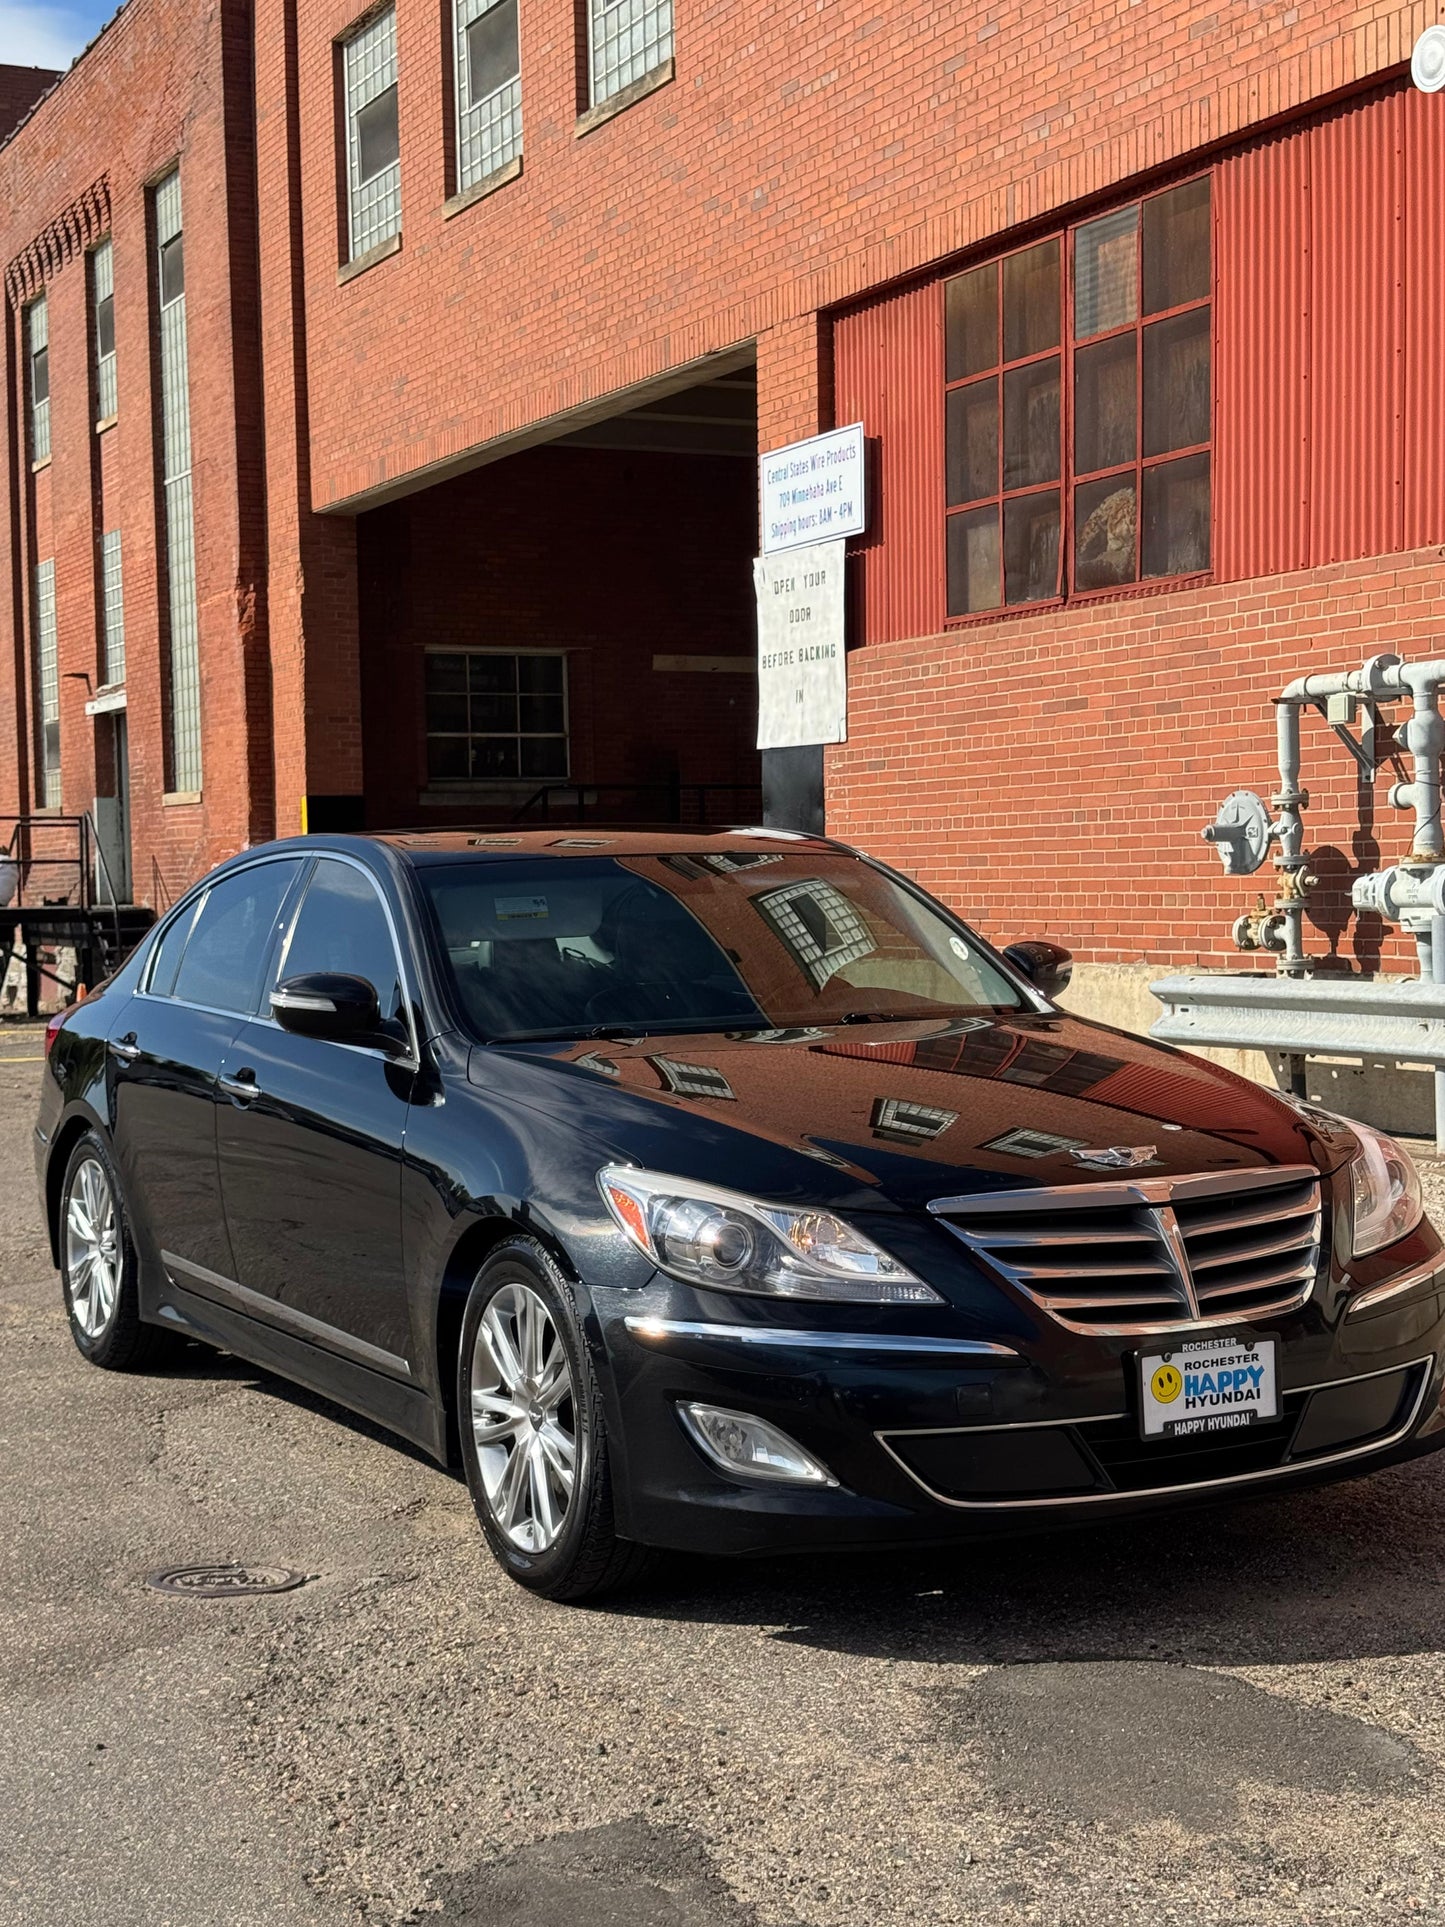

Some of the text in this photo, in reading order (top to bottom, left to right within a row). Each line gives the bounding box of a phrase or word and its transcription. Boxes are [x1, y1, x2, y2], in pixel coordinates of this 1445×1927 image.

[767, 444, 856, 485] Central States Wire Products
[791, 483, 824, 505] Minnehaha
[826, 479, 838, 494] Ave
[838, 475, 843, 491] E
[771, 518, 797, 540] Shipping
[798, 514, 818, 531] hours:
[819, 506, 832, 525] 8AM
[838, 501, 853, 519] 4PM
[774, 570, 826, 595] OPEN YOUR
[789, 607, 811, 623] DOOR
[762, 644, 836, 669] BEFORE BACKING
[795, 689, 804, 704] IN
[1182, 1337, 1237, 1352] ROCHESTER
[1184, 1353, 1260, 1371] ROCHESTER
[1184, 1364, 1265, 1397] HAPPY
[1185, 1388, 1261, 1409] HYUNDAI
[1174, 1413, 1250, 1436] HAPPY HYUNDAI
